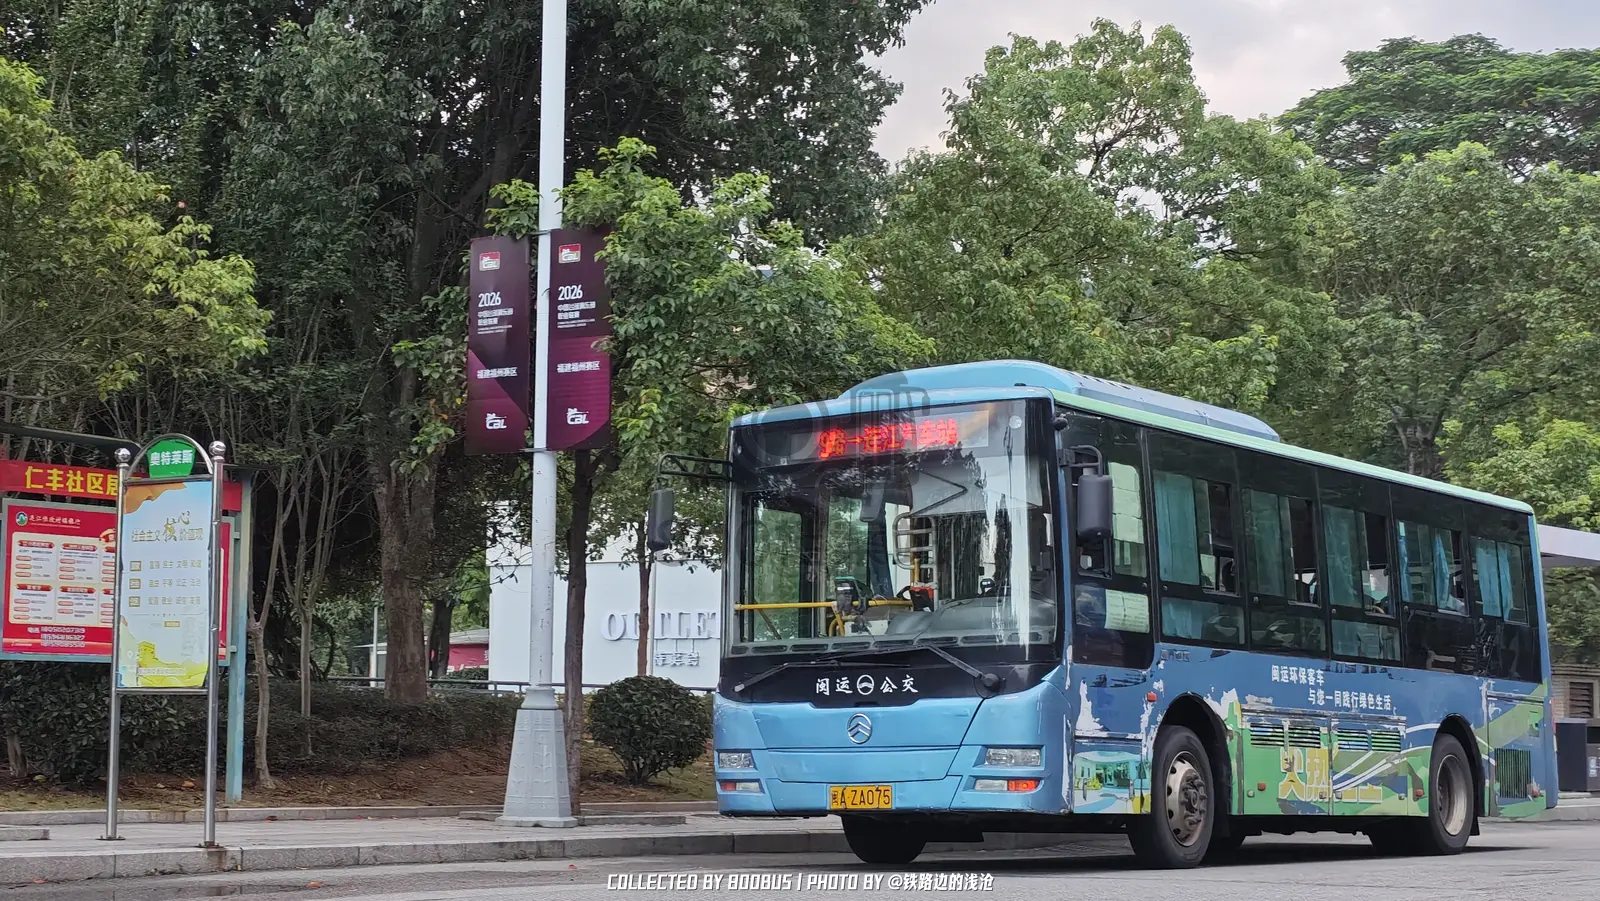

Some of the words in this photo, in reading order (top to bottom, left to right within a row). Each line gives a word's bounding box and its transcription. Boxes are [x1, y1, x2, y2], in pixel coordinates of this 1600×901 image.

[478, 291, 502, 308] 2026
[558, 284, 583, 301] 2026
[150, 449, 194, 466] 奥特莱斯
[815, 677, 853, 696] 闽运
[880, 674, 919, 694] 公交
[1271, 664, 1325, 687] 闽运环保客车
[1308, 687, 1391, 711] 与您一同践行绿色生活
